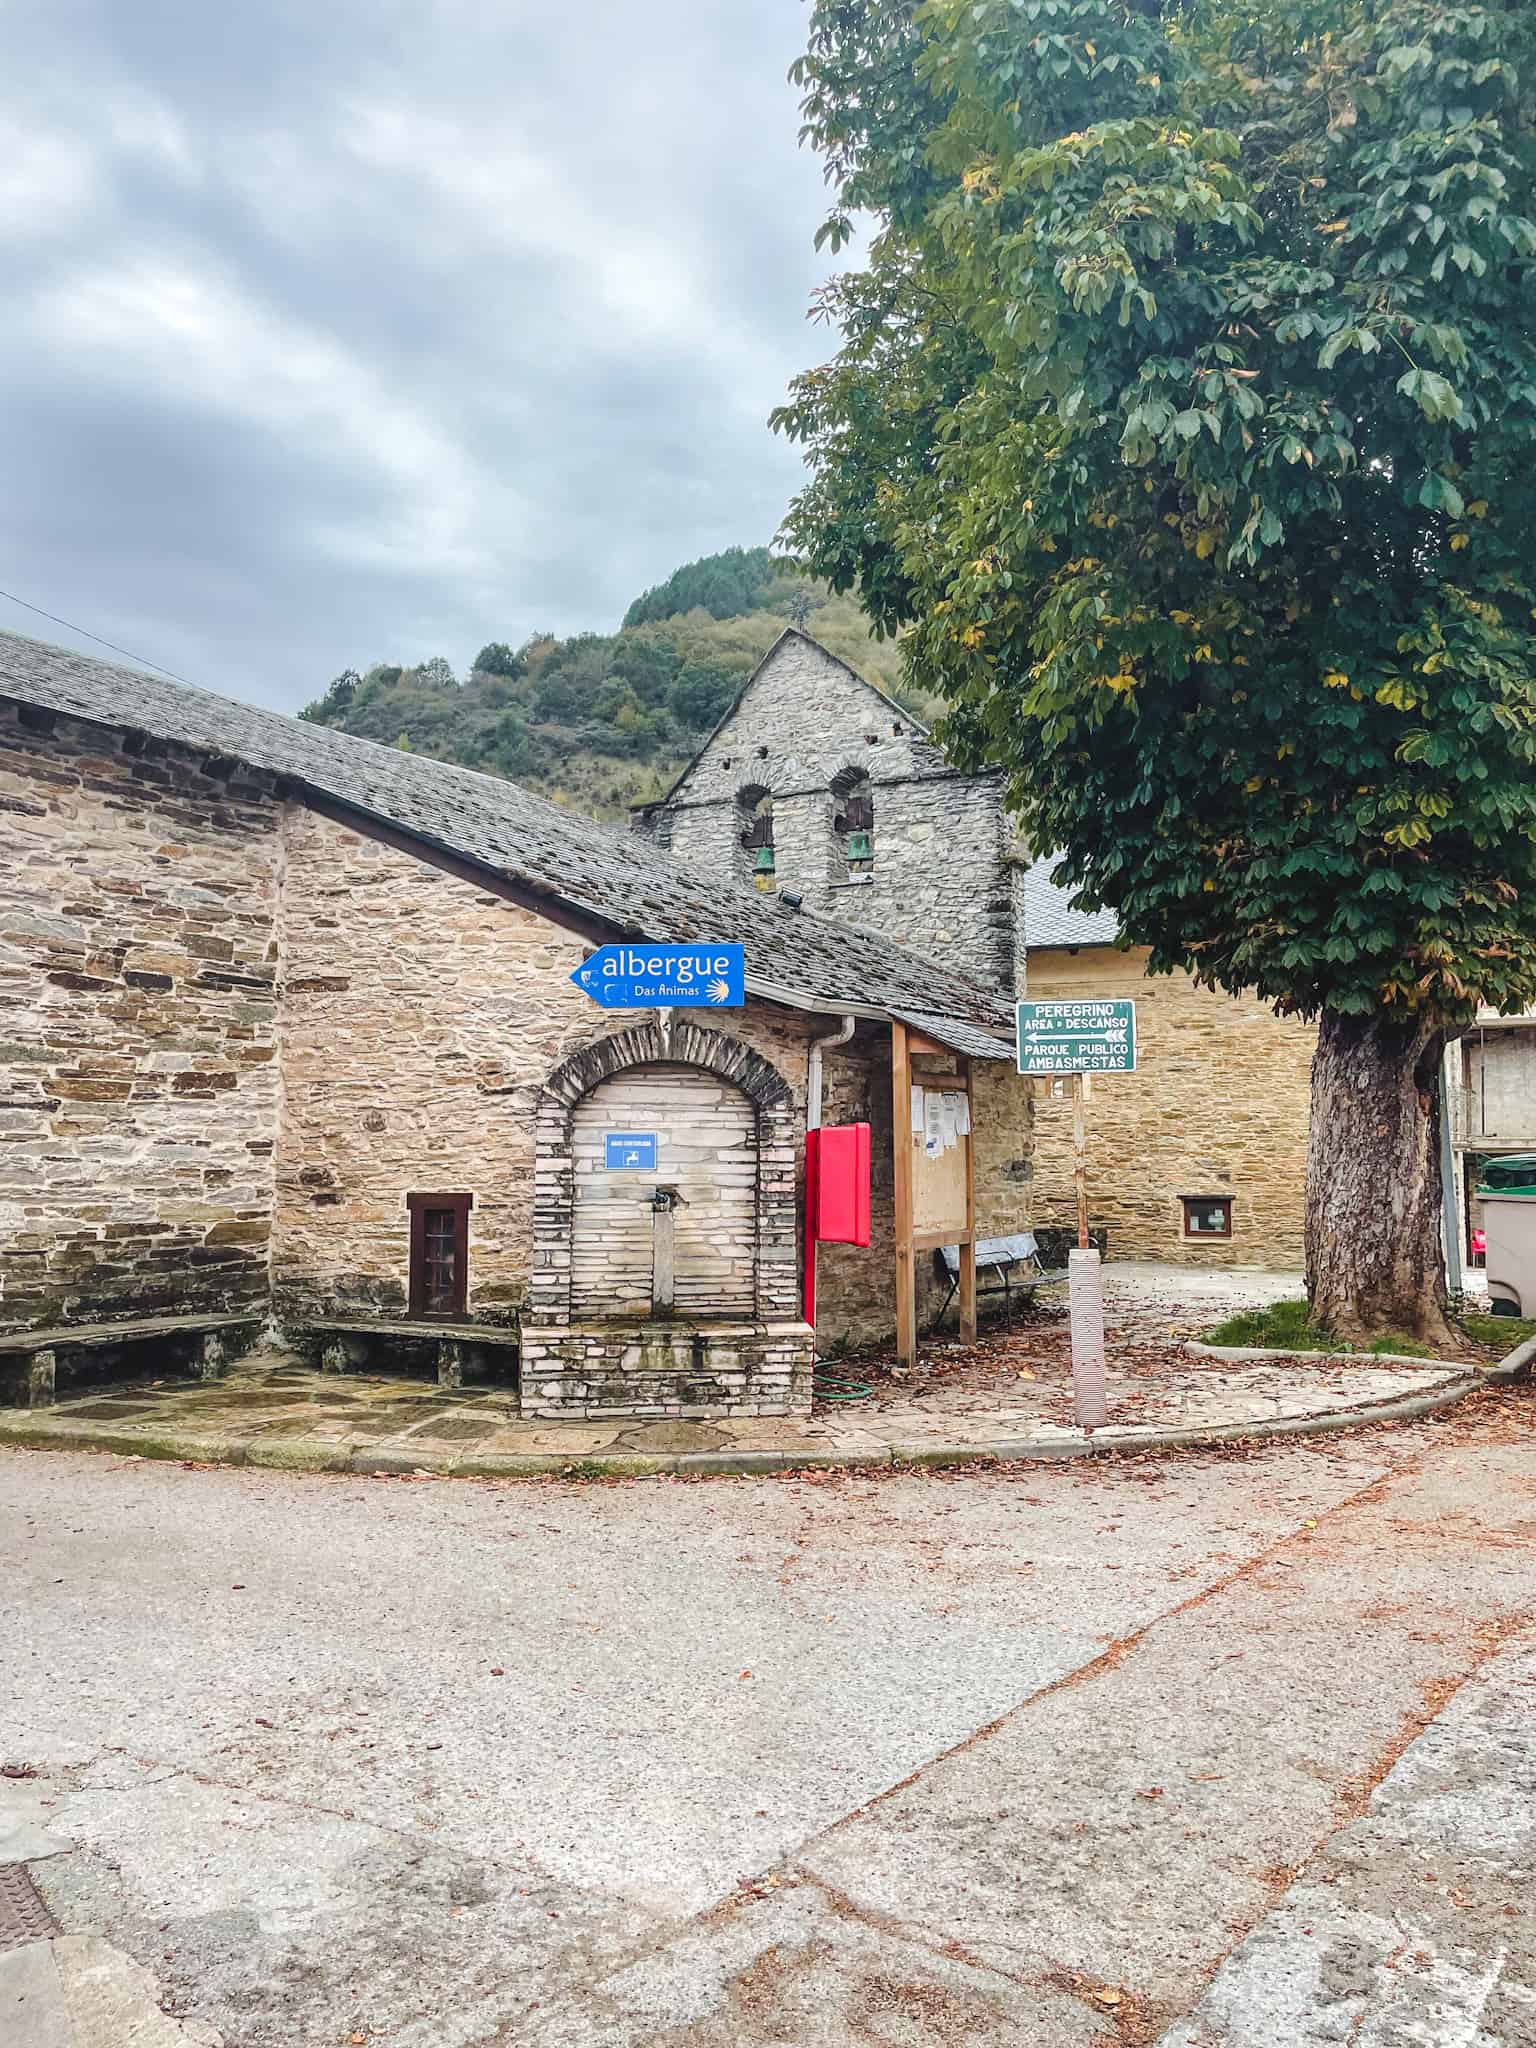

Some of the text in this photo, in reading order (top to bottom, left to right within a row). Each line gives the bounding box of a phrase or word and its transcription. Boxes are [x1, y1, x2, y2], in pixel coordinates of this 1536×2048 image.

[602, 950, 730, 983] albergue
[634, 985, 656, 997] Das
[1036, 1004, 1114, 1017] PEREGRINO
[1025, 1020, 1053, 1029] AREA
[1066, 1018, 1128, 1028] DESCANSO
[1025, 1044, 1128, 1055] PARQUE PUBLICO
[1028, 1056, 1125, 1069] AMBASMESTAS
